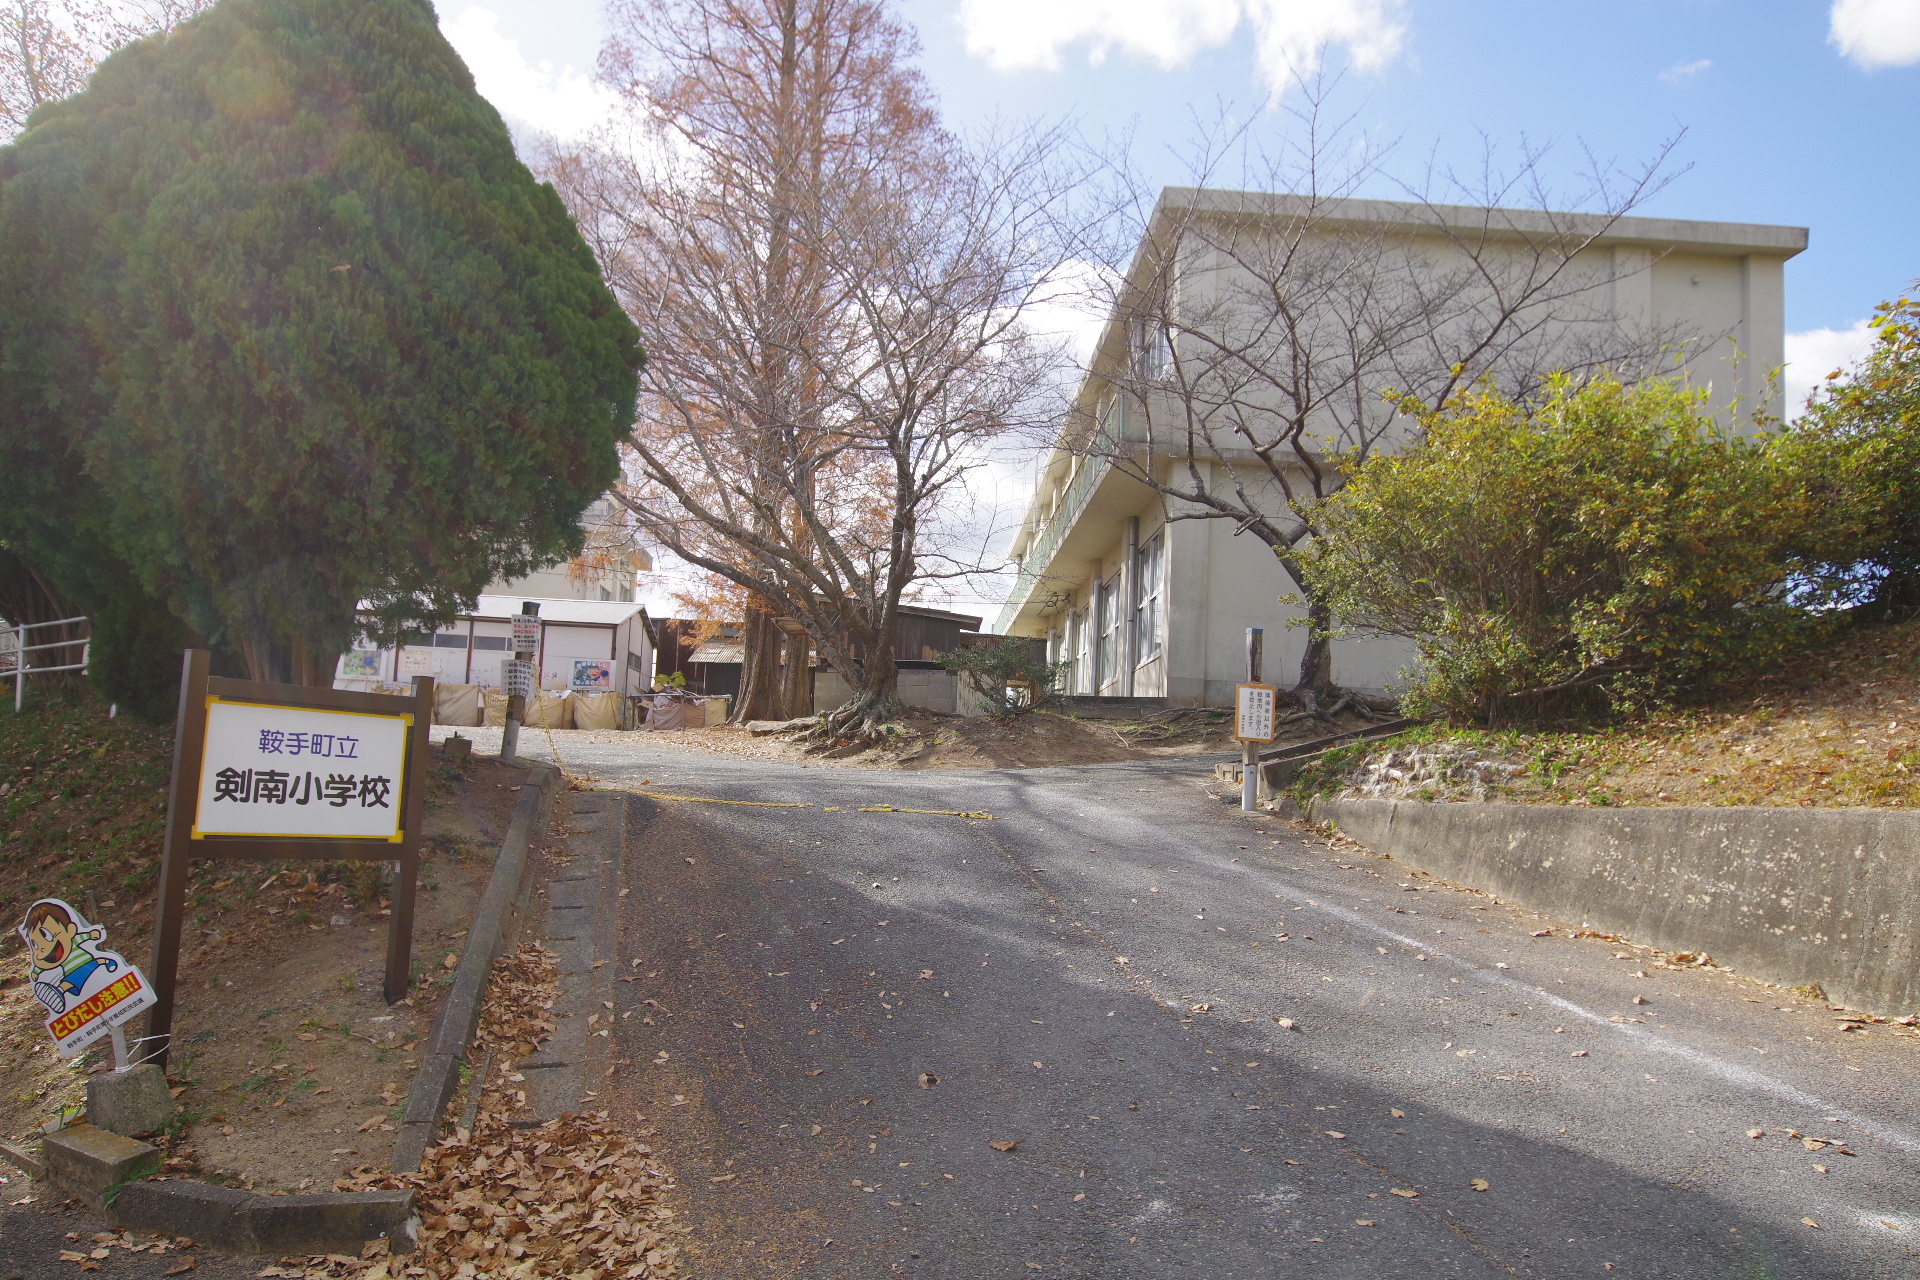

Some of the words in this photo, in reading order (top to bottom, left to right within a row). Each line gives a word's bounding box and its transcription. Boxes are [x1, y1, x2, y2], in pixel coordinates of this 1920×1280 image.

[258, 728, 359, 759] 鞍手町立
[213, 766, 391, 809] 剣南小学校
[53, 974, 139, 1037] とびだし注意!!
